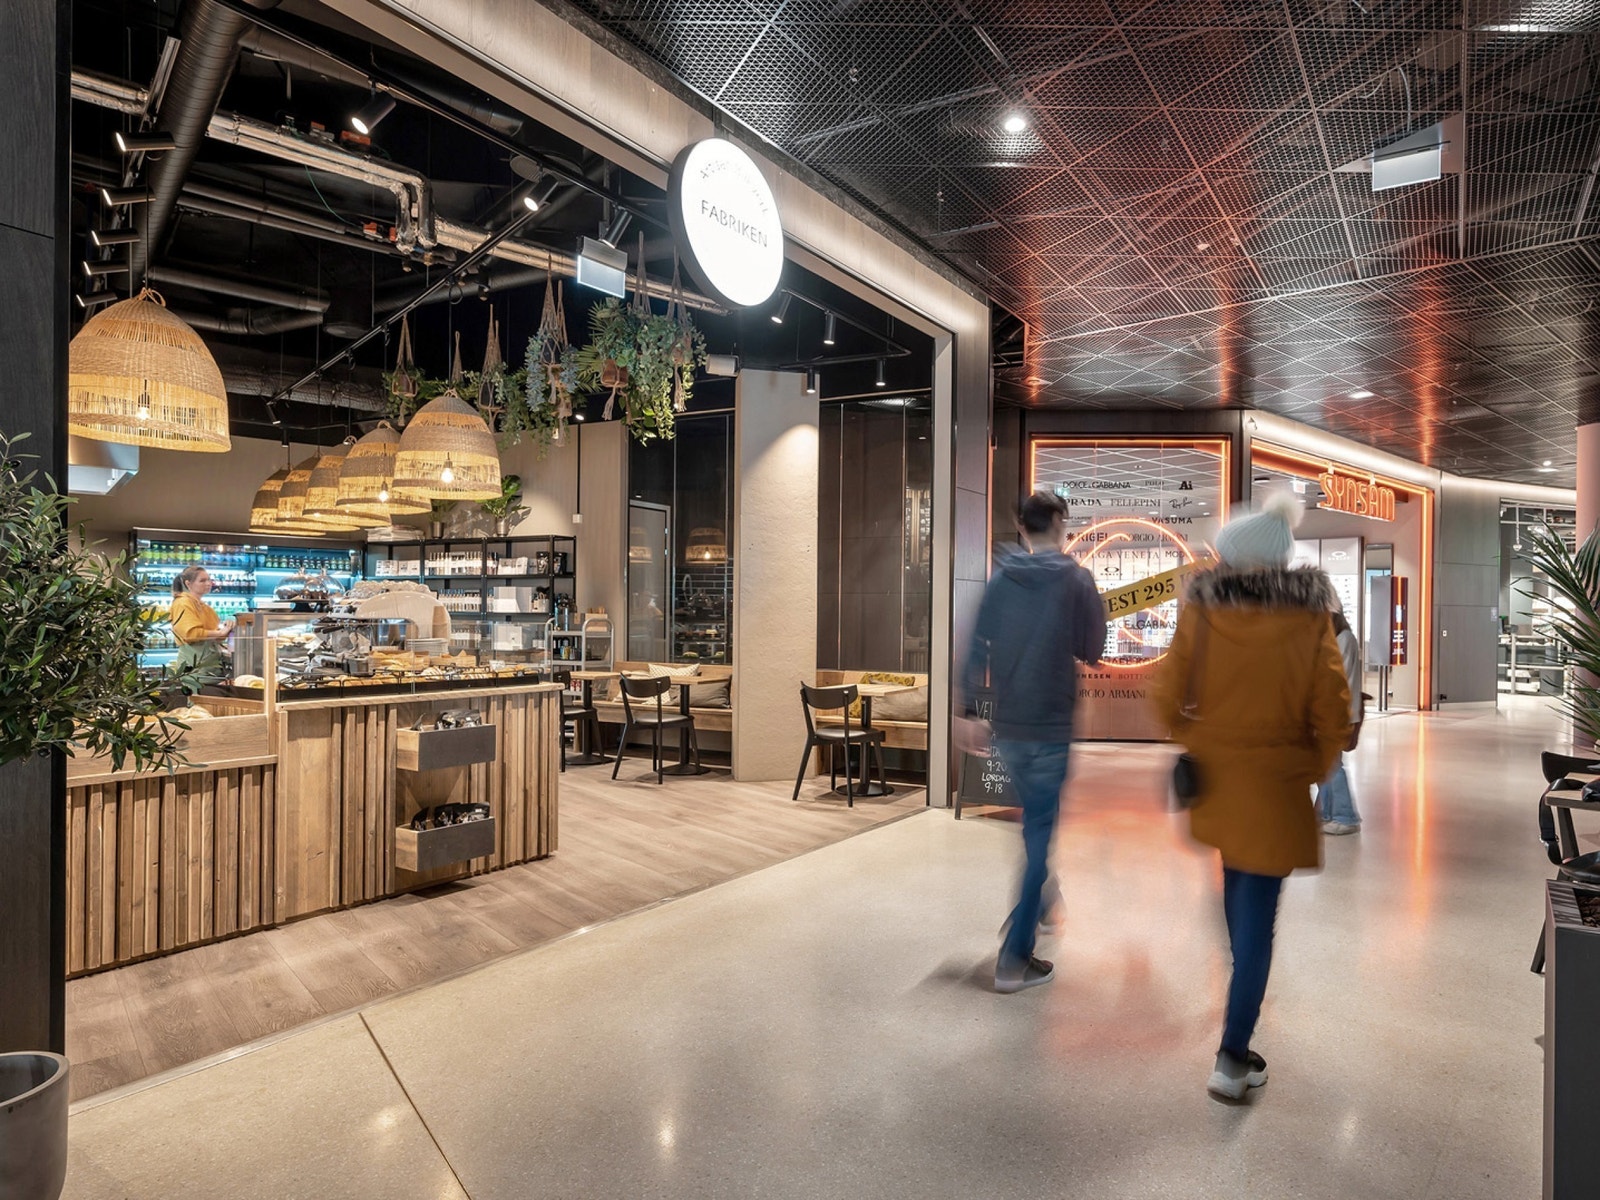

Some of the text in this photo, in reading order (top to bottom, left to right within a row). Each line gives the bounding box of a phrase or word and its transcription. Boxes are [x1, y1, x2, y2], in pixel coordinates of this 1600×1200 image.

[701, 199, 768, 248] FABRIKEN
[1178, 480, 1193, 490] Ai
[1318, 472, 1396, 522] SYNSAM
[1119, 533, 1155, 542] GORGIO
[1105, 589, 1139, 613] EST
[1143, 578, 1176, 601] 295
[1109, 689, 1146, 699] ARMANI
